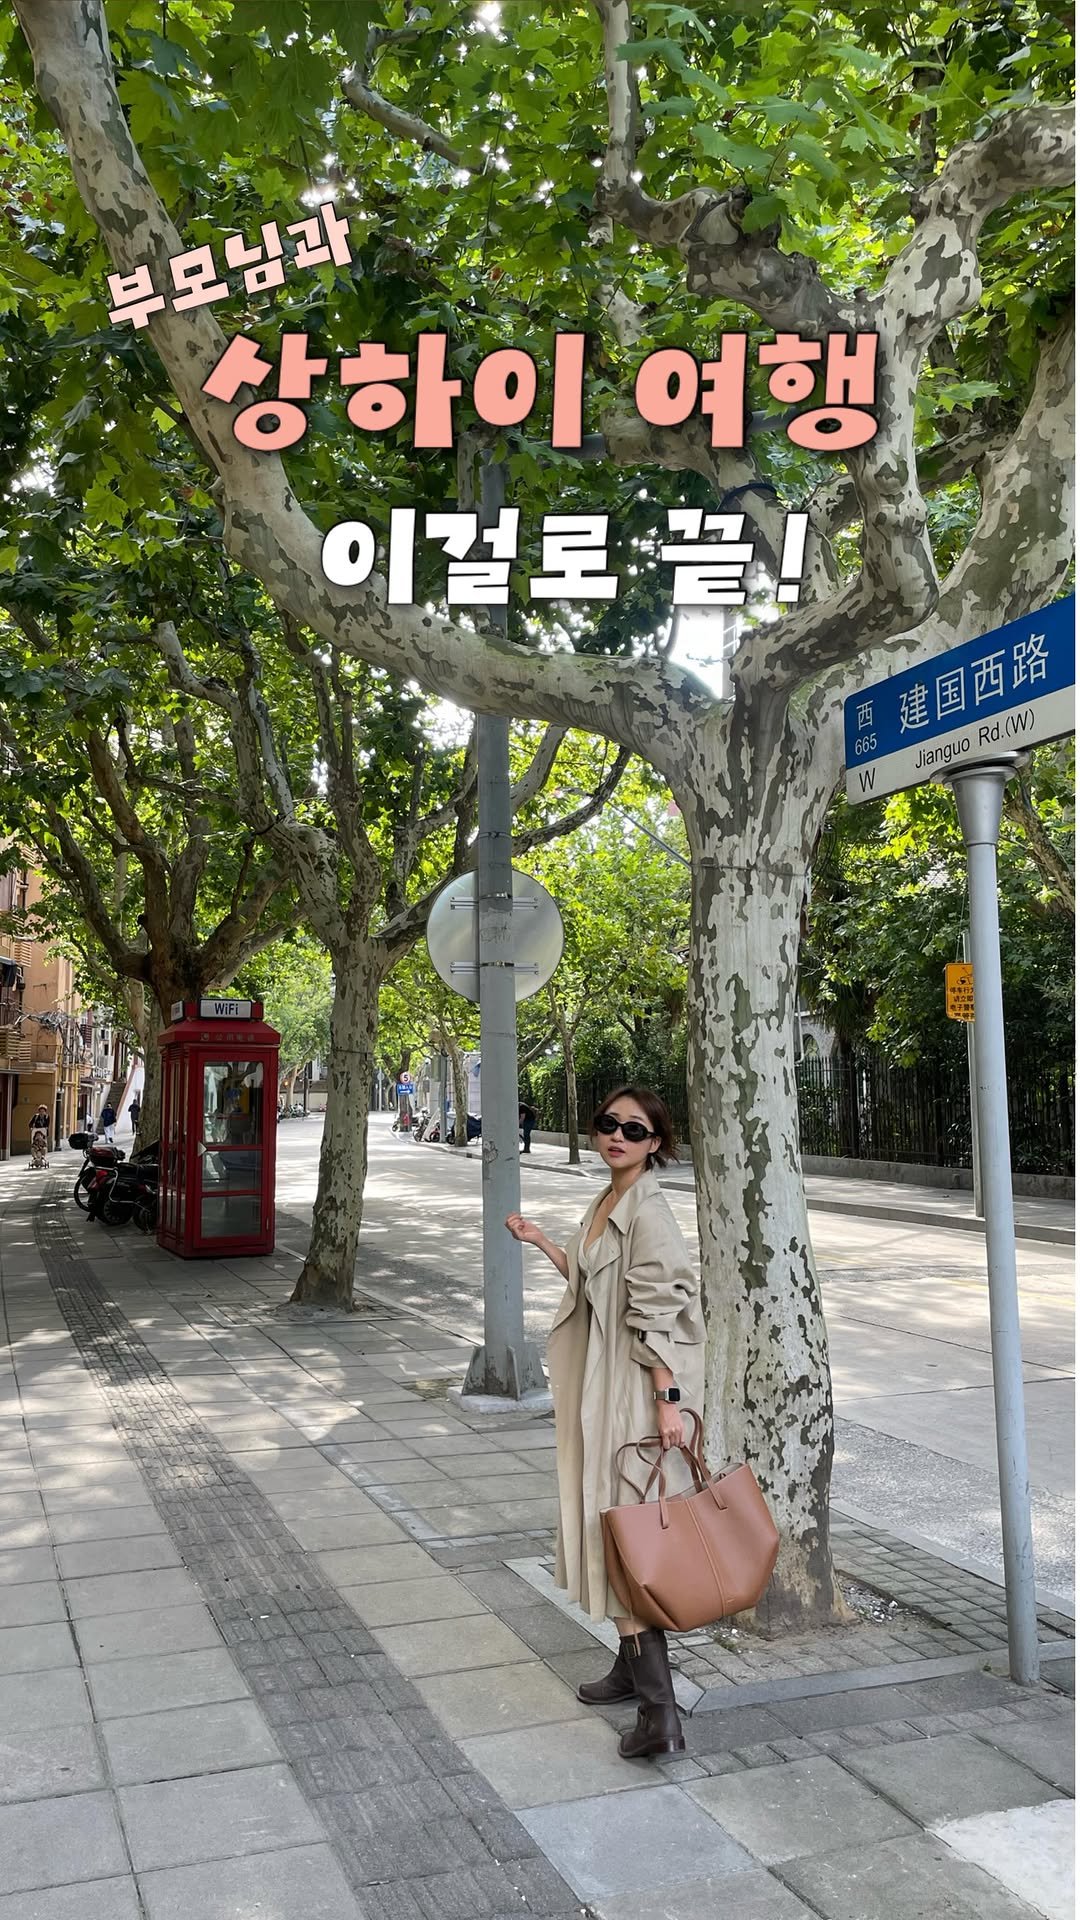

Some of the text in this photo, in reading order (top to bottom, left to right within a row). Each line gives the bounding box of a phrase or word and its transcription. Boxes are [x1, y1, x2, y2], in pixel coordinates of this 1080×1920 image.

[899, 633, 1049, 734] 建国西路
[856, 700, 874, 731] 西
[854, 733, 877, 756] 665
[915, 738, 970, 769] Jianguo
[859, 767, 876, 793] W
[214, 1002, 239, 1016] WiFi
[403, 1074, 409, 1082] 5
